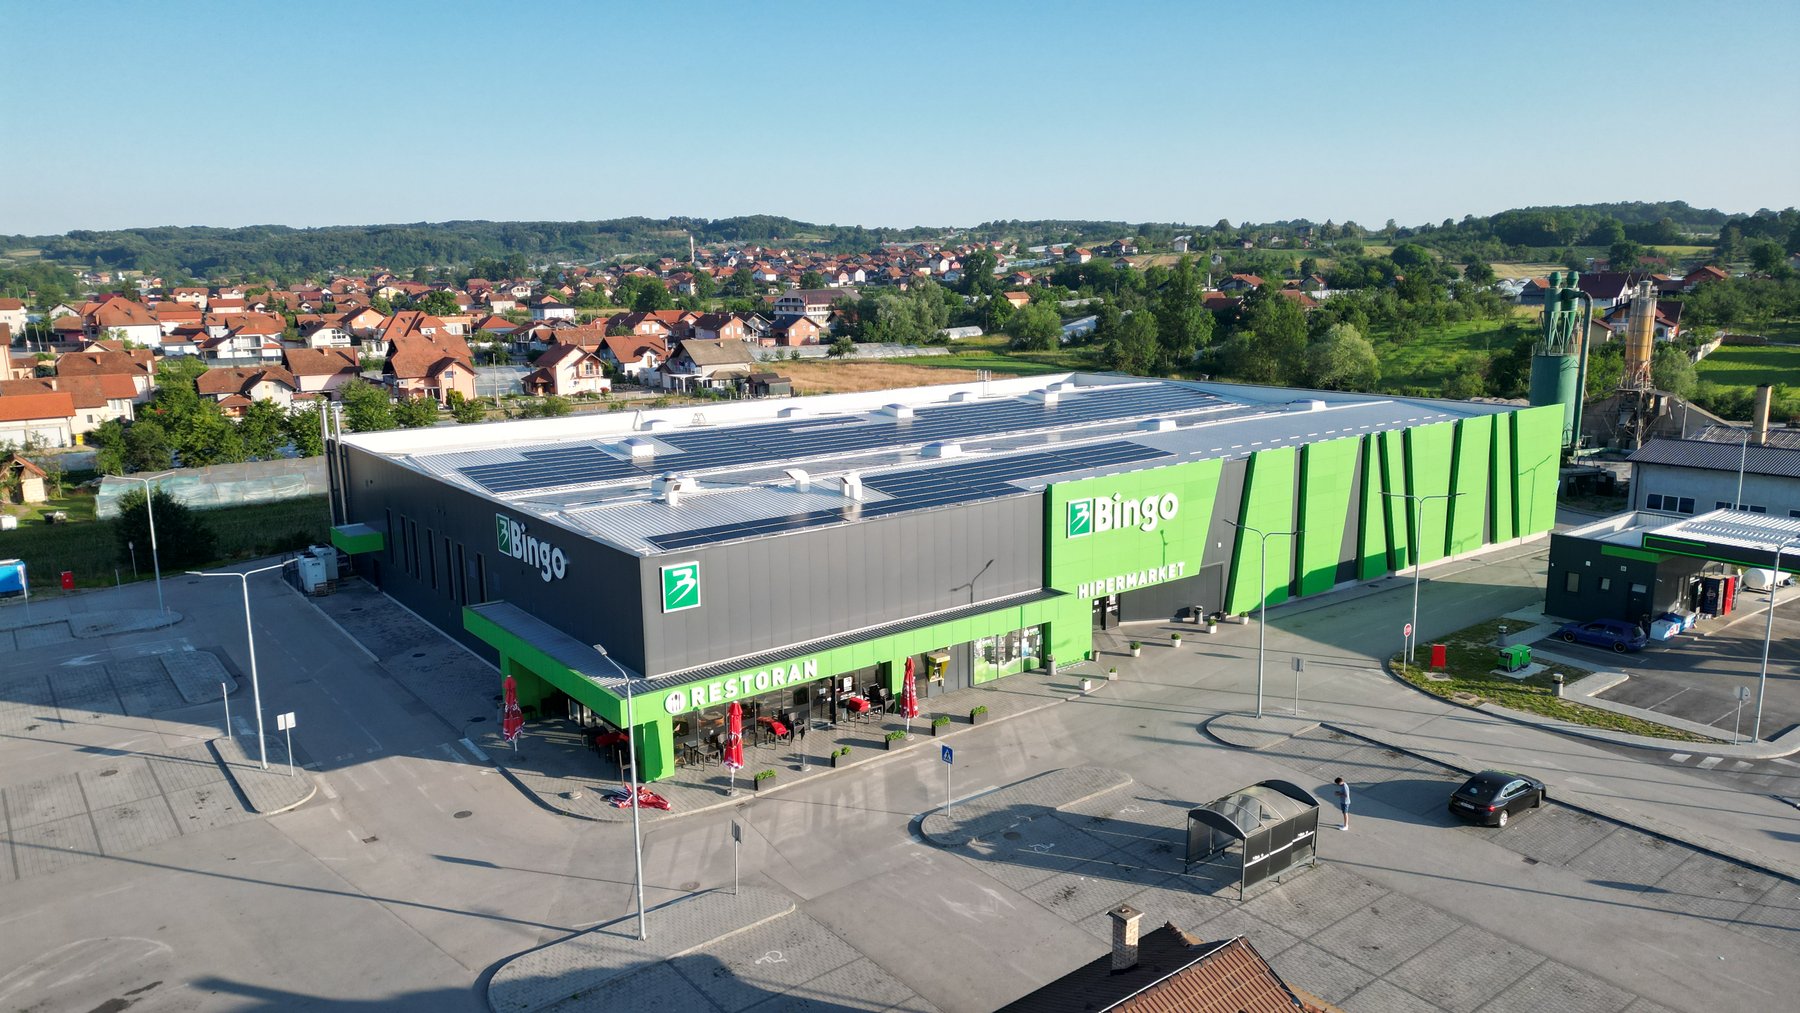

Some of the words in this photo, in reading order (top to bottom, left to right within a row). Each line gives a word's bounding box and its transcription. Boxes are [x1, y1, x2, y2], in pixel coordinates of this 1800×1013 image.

[1093, 492, 1179, 532] Bingo
[510, 520, 566, 582] Bingo
[1078, 561, 1185, 600] HIPERMARKET
[690, 659, 818, 708] RESTORAN
